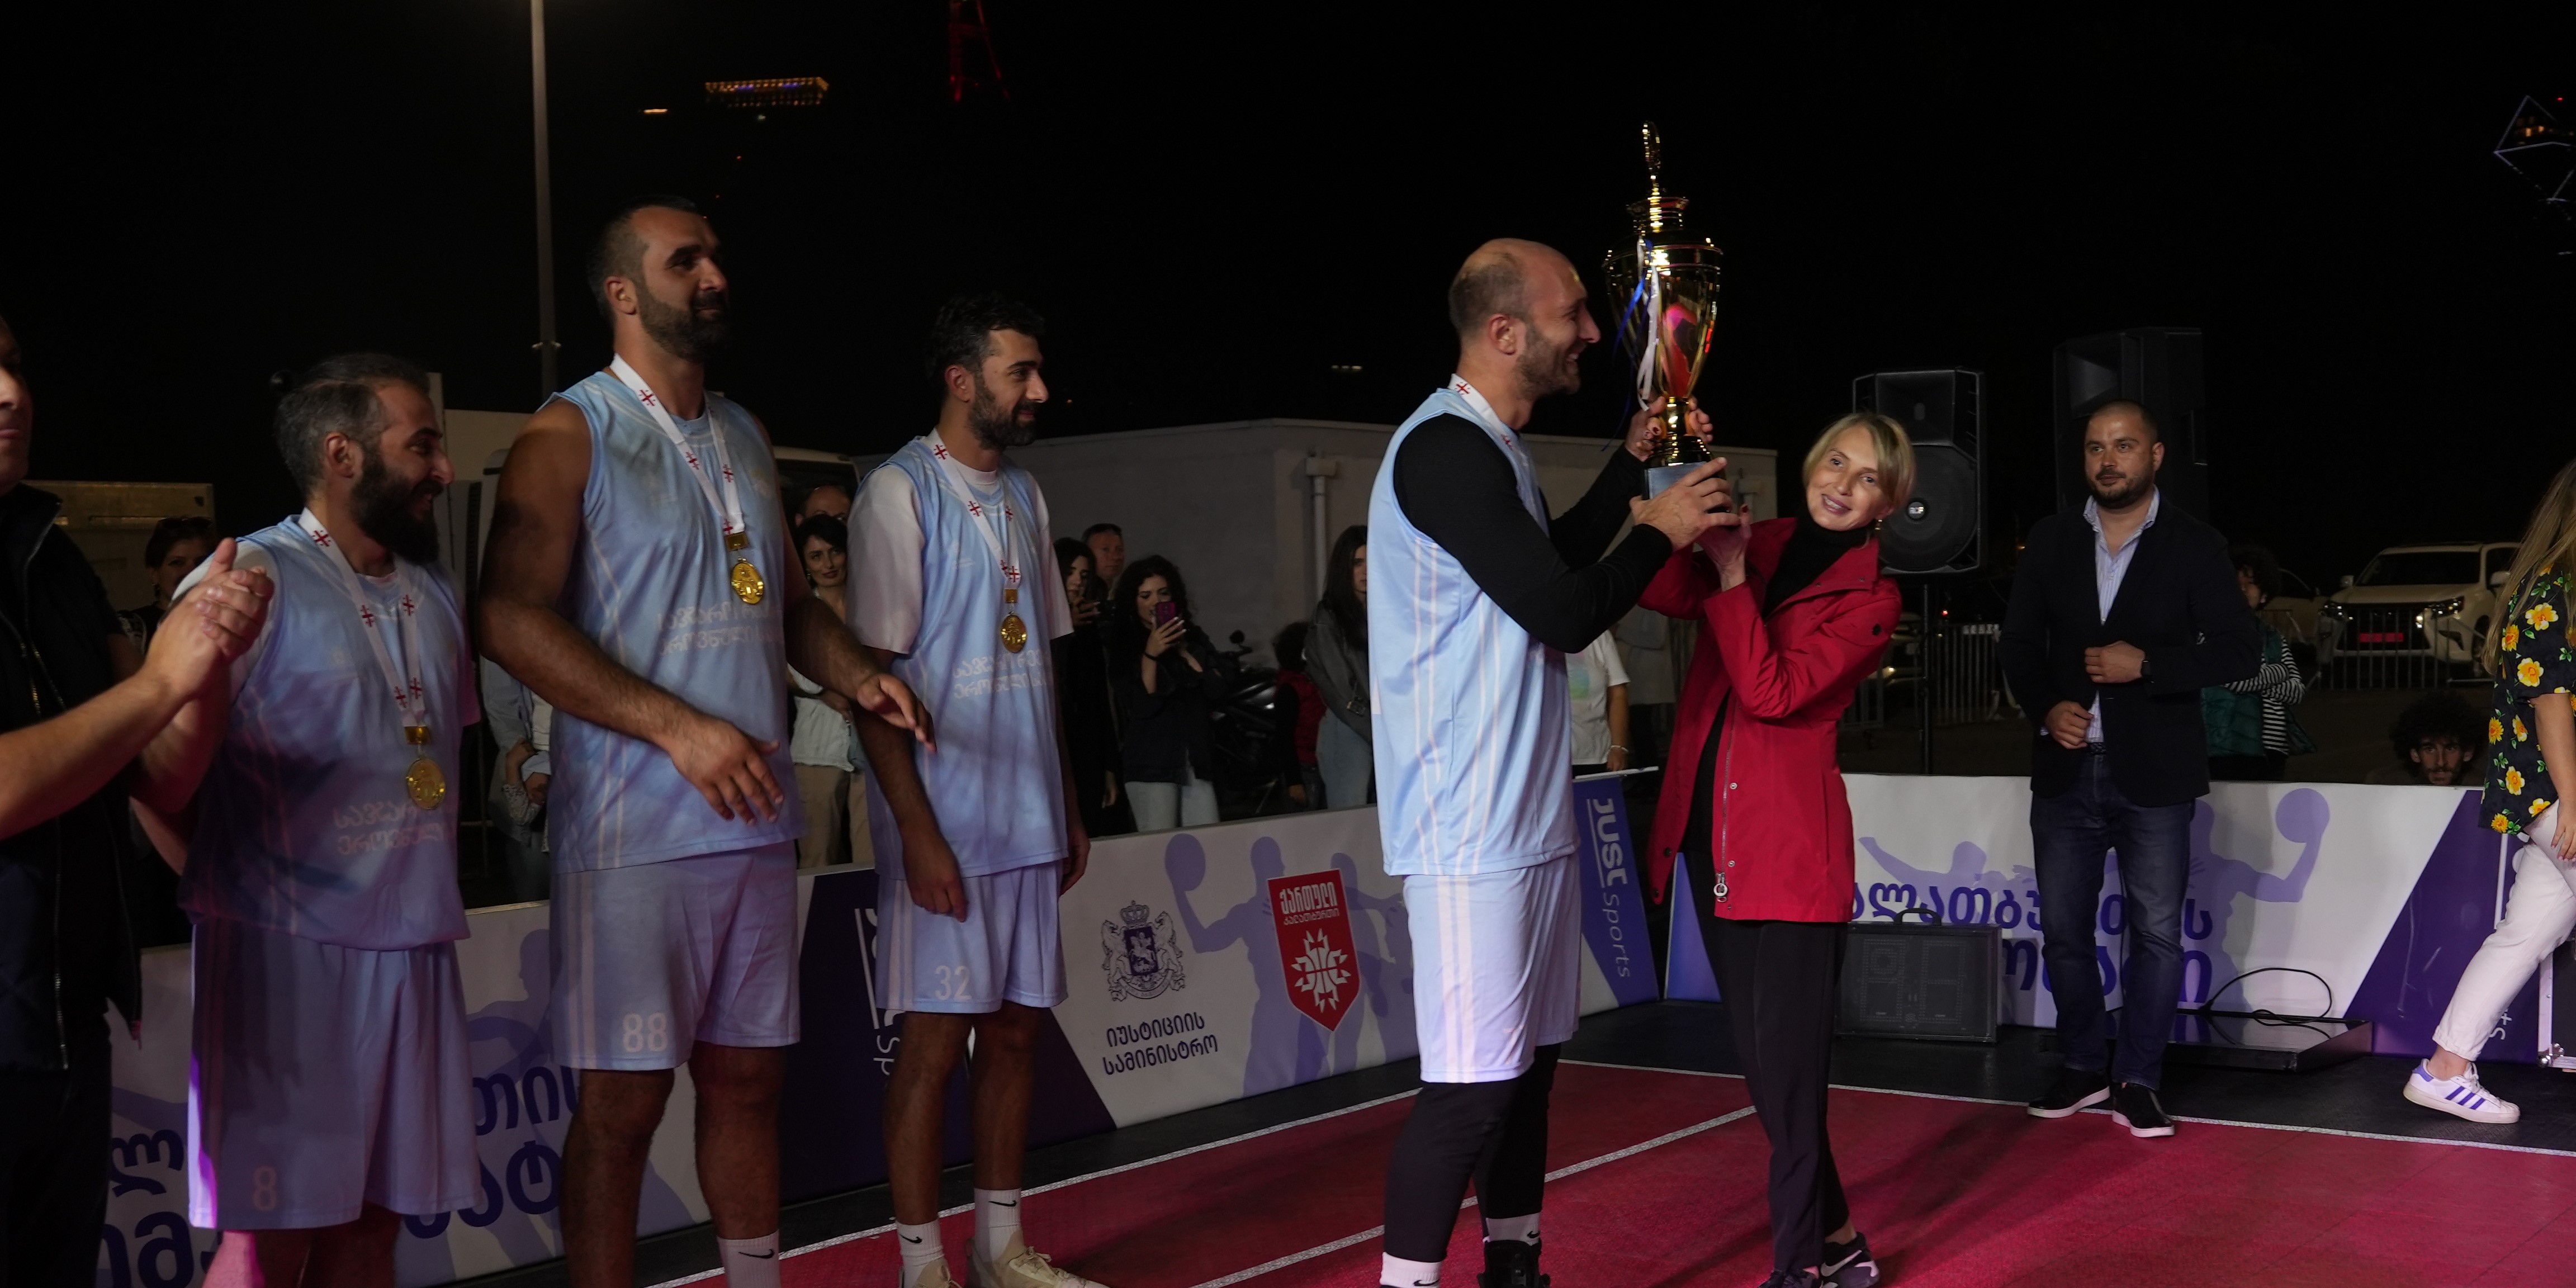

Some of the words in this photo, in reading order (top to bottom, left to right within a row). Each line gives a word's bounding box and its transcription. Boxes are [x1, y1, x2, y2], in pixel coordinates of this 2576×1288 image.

[1279, 881, 1338, 915] ქართული
[934, 965, 972, 1000] 32
[623, 1012, 668, 1052] 88
[1107, 1012, 1205, 1047] იუსტიციის
[1102, 1034, 1218, 1075] სამინისტრო
[253, 1166, 277, 1211] 8
